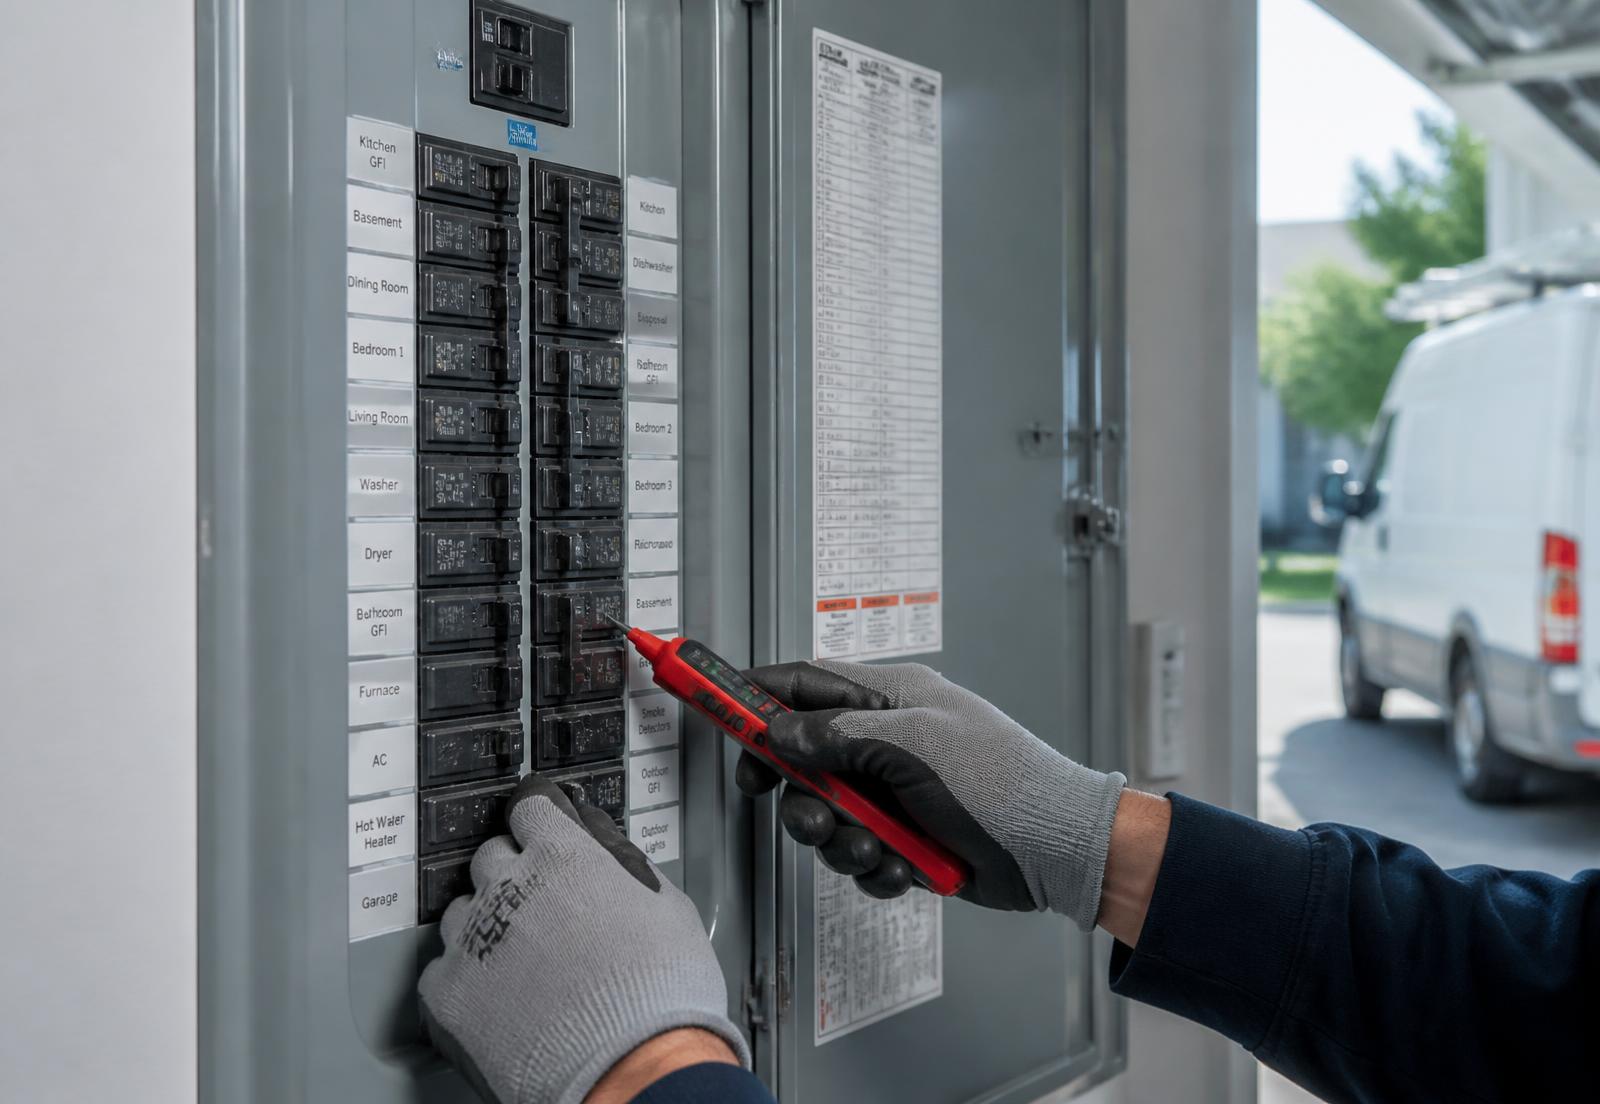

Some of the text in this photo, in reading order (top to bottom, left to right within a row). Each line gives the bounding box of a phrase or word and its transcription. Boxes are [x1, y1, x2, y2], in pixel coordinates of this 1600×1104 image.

[359, 135, 397, 154] Kitchen
[370, 156, 387, 170] GFI
[353, 210, 402, 229] Basement
[348, 275, 409, 294] Dining Room
[352, 342, 404, 357] Bedroom 1
[348, 411, 409, 425] Living Room
[635, 422, 673, 434] Bedroom 2
[360, 478, 399, 491] Washer
[635, 480, 673, 491] Bedroom 3
[364, 548, 393, 562] Dryer
[370, 623, 387, 637] GFI
[359, 684, 401, 699] Furnace
[372, 753, 388, 768] AC
[647, 782, 661, 794] GFI
[356, 819, 375, 834] Hot
[364, 834, 398, 850] Heater
[361, 892, 399, 910] Garage
